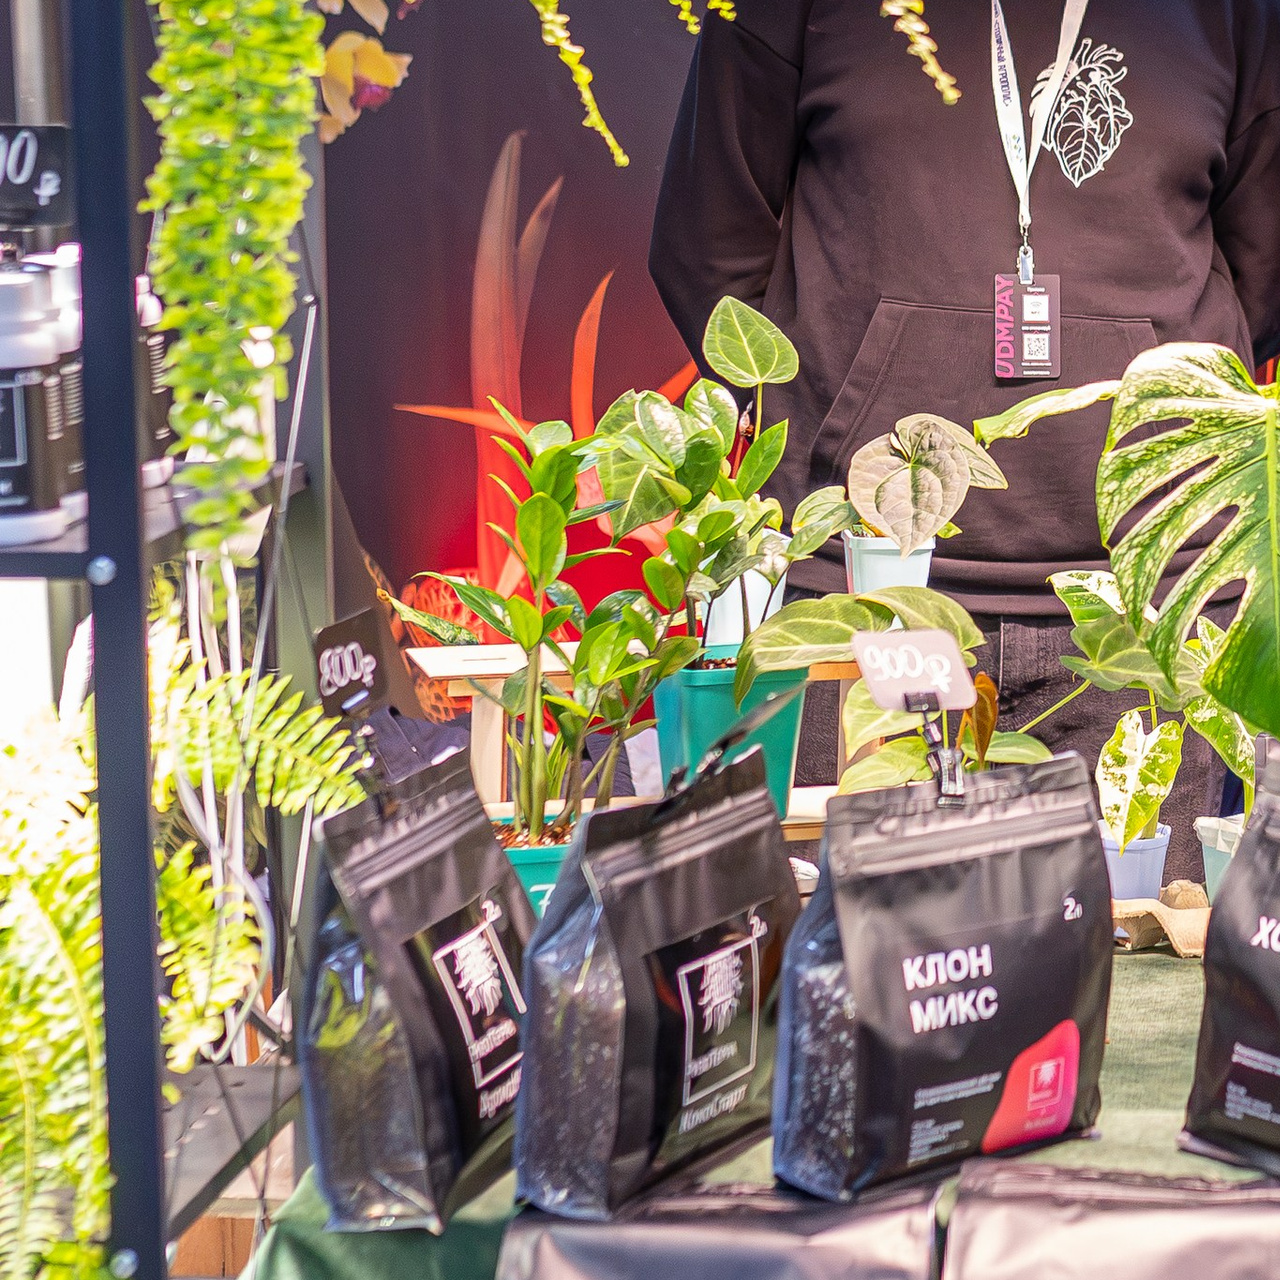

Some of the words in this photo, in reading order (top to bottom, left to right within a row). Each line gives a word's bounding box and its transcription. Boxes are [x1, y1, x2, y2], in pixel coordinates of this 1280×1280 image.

[996, 274, 1015, 378] UDMPAY
[902, 943, 993, 992] КЛОН
[909, 985, 999, 1034] МИКС
